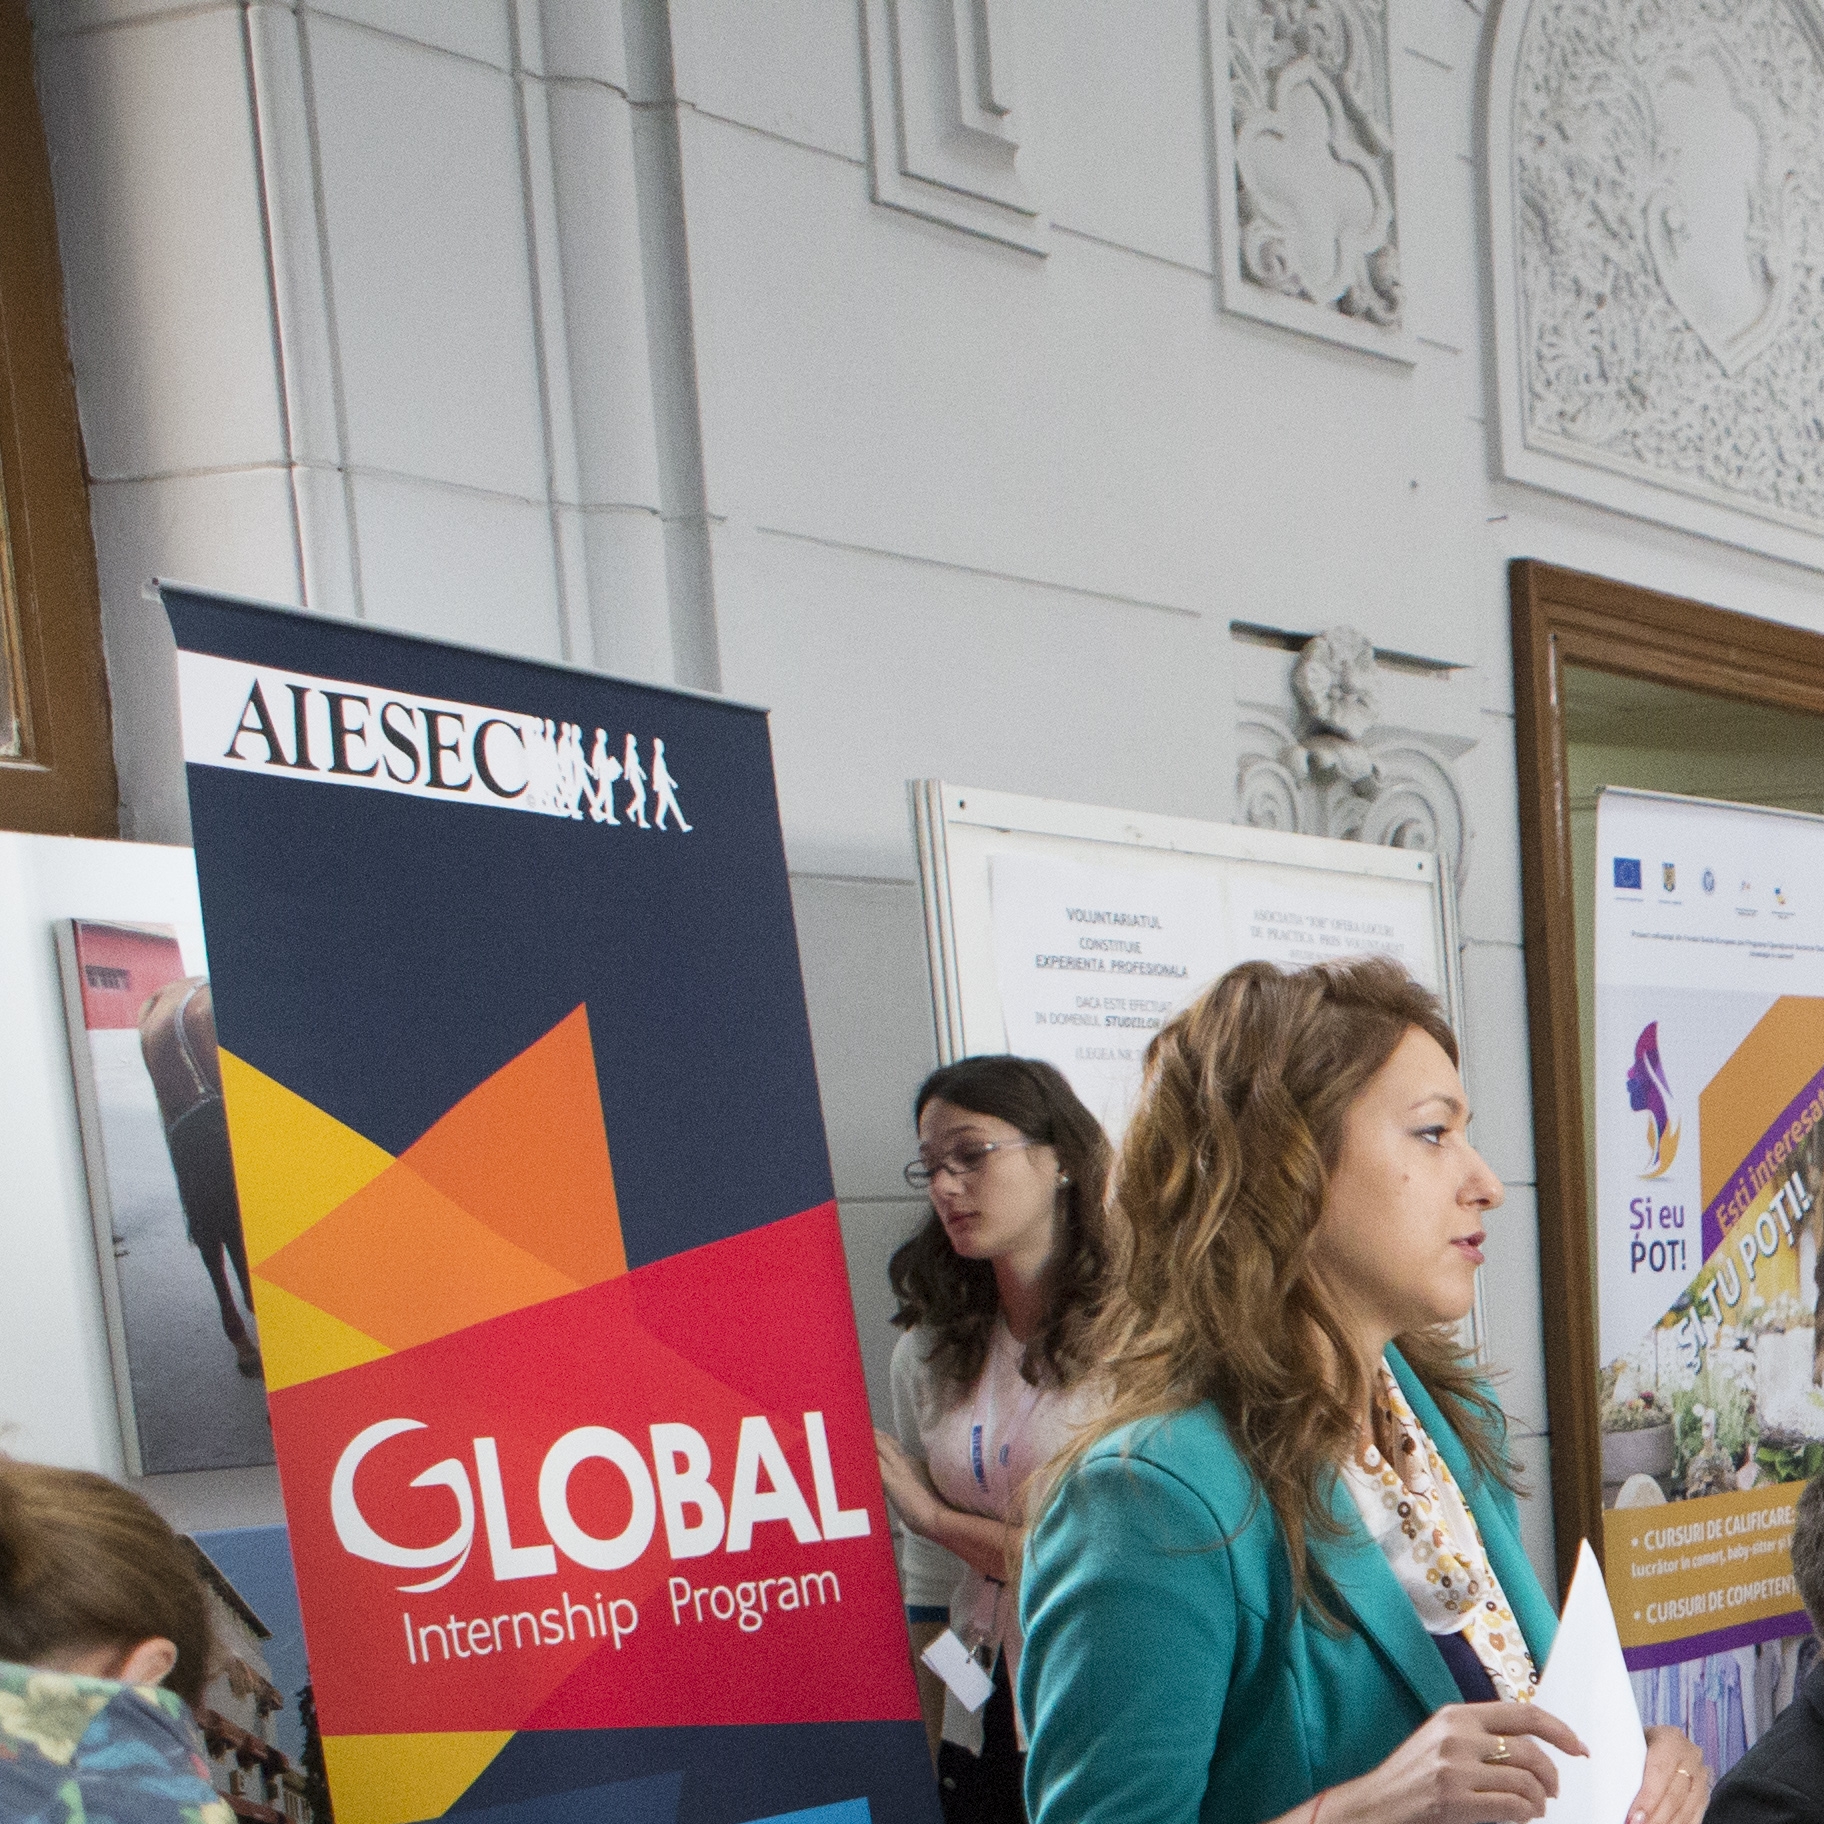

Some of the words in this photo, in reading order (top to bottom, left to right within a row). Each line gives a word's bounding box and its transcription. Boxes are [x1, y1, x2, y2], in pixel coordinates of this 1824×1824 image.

[224, 678, 529, 798] AIESEC
[1065, 906, 1162, 929] VOLUNTARIATUL
[1079, 937, 1142, 954] CONSTITUIE
[1110, 959, 1189, 978] PROFESIONALA
[1659, 1201, 1685, 1229] eu
[1630, 1238, 1687, 1274] POT!
[1701, 1256, 1742, 1327] TU
[330, 1410, 871, 1593] GLOBAL
[1644, 1521, 1705, 1551] CURSURI
[1706, 1518, 1722, 1541] DE
[403, 1591, 639, 1665] Internship
[669, 1568, 841, 1634] Program
[1646, 1594, 1707, 1625] CURSURI
[1708, 1589, 1725, 1613] DE
